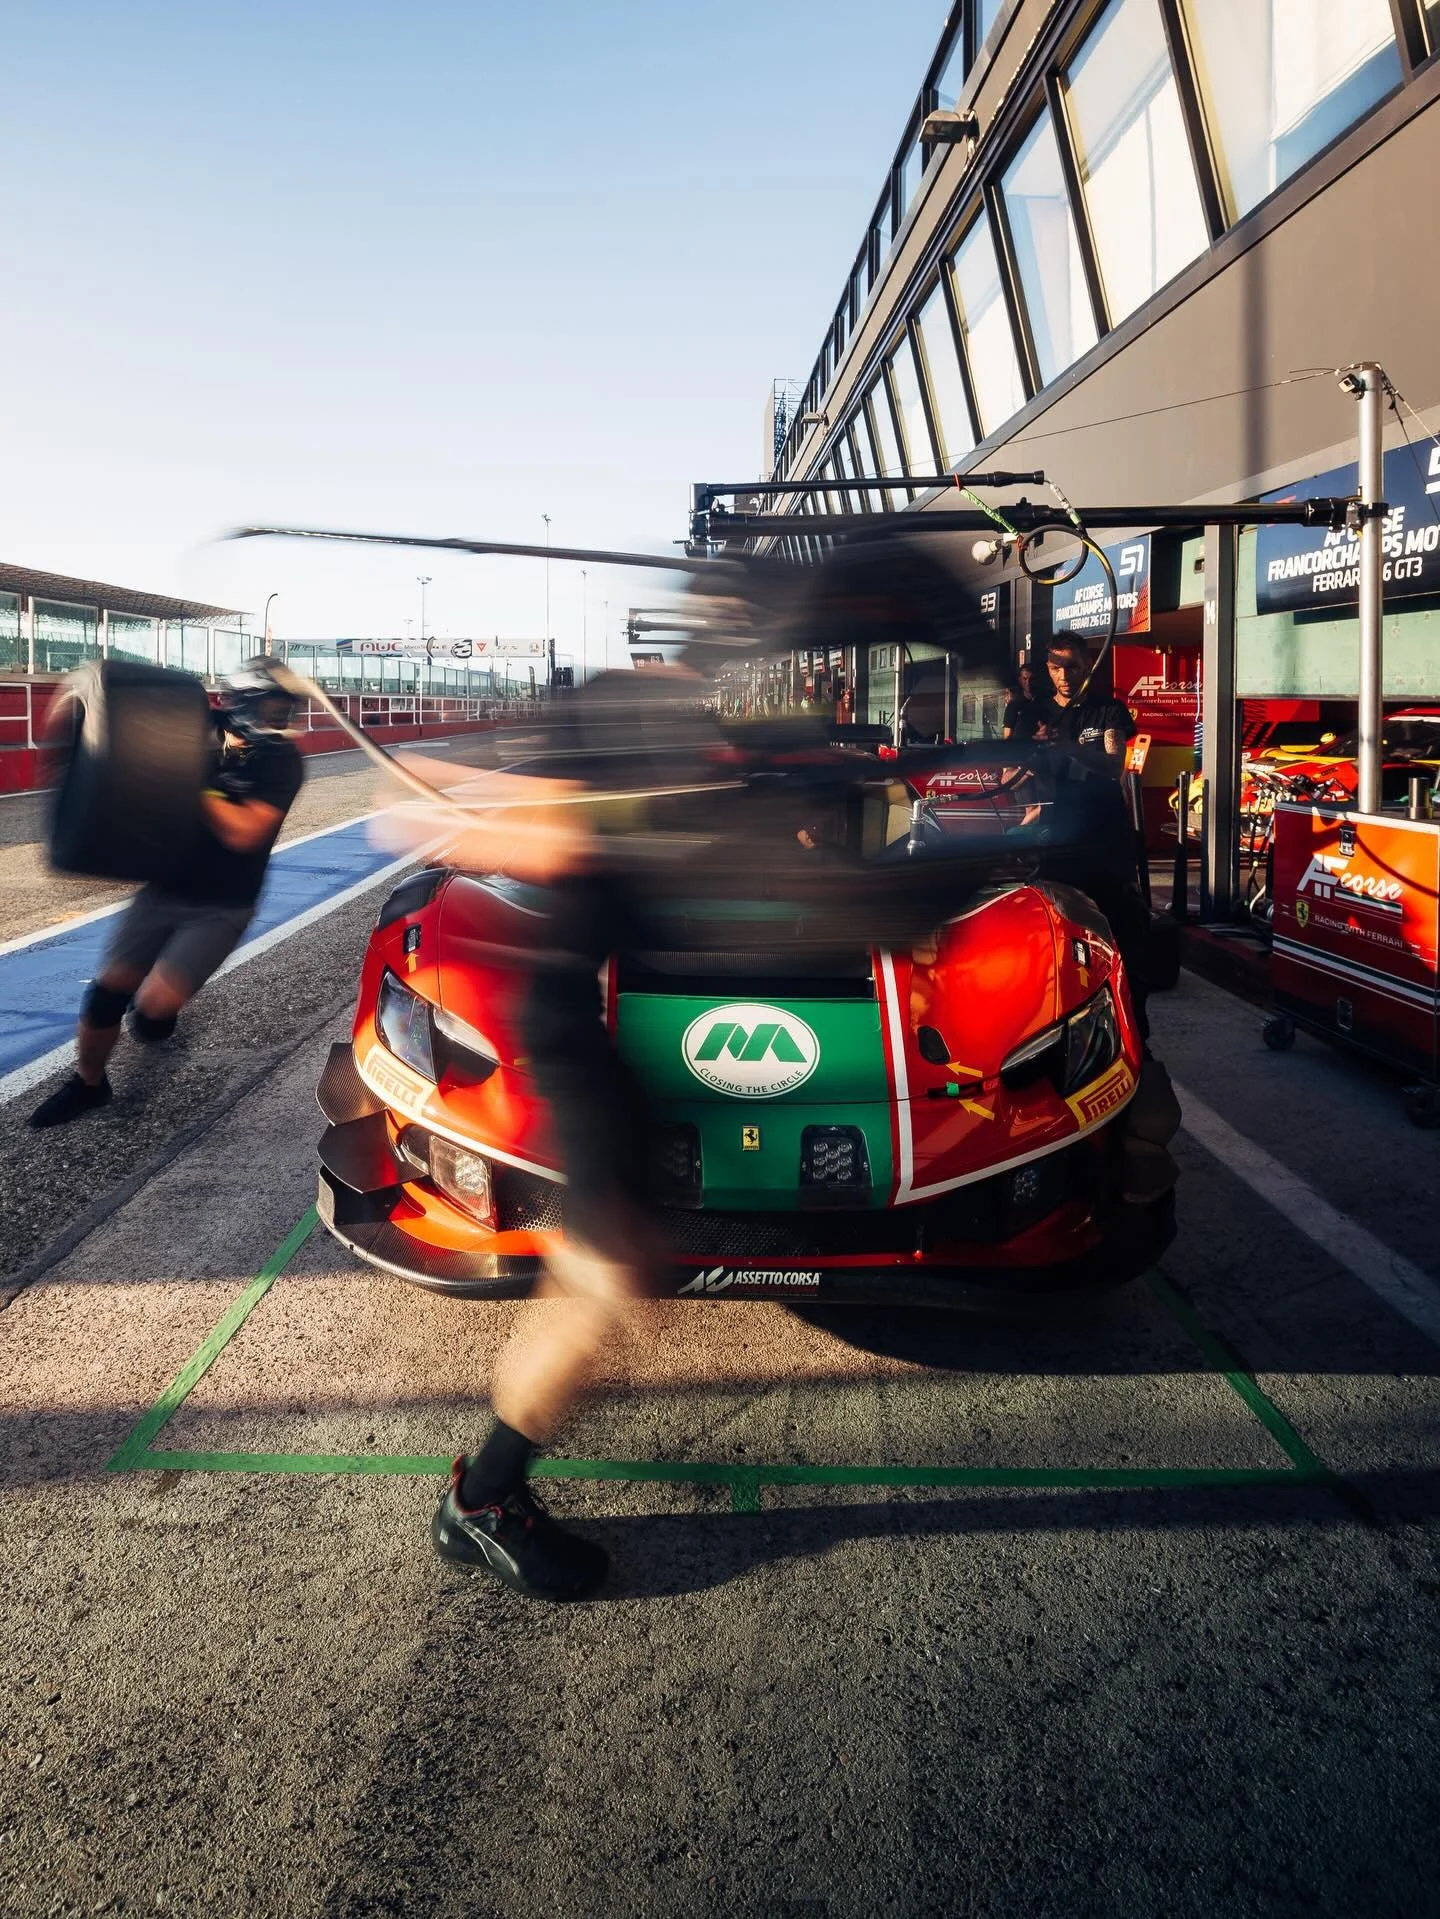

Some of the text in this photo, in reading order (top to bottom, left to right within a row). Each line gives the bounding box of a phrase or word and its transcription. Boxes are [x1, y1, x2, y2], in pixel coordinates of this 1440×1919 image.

[1119, 543, 1145, 577] 51
[1267, 532, 1403, 582] FRANCORCHAPS
[1404, 524, 1440, 555] MO
[1312, 567, 1361, 593] FERRAR
[1394, 556, 1423, 580] GT3
[981, 592, 997, 613] 93
[1104, 591, 1139, 612] MTORS
[1100, 612, 1110, 625] GT3
[1340, 872, 1403, 900] corse
[1314, 914, 1346, 930] RACING
[1366, 930, 1403, 949] FERRARI
[366, 1052, 424, 1108] PIRELLI
[700, 1067, 804, 1094] CLOSING THE CIRCLE
[1075, 1068, 1132, 1124] PIRELLI
[733, 1271, 784, 1285] ASSETTO
[783, 1272, 820, 1286] CORSA
